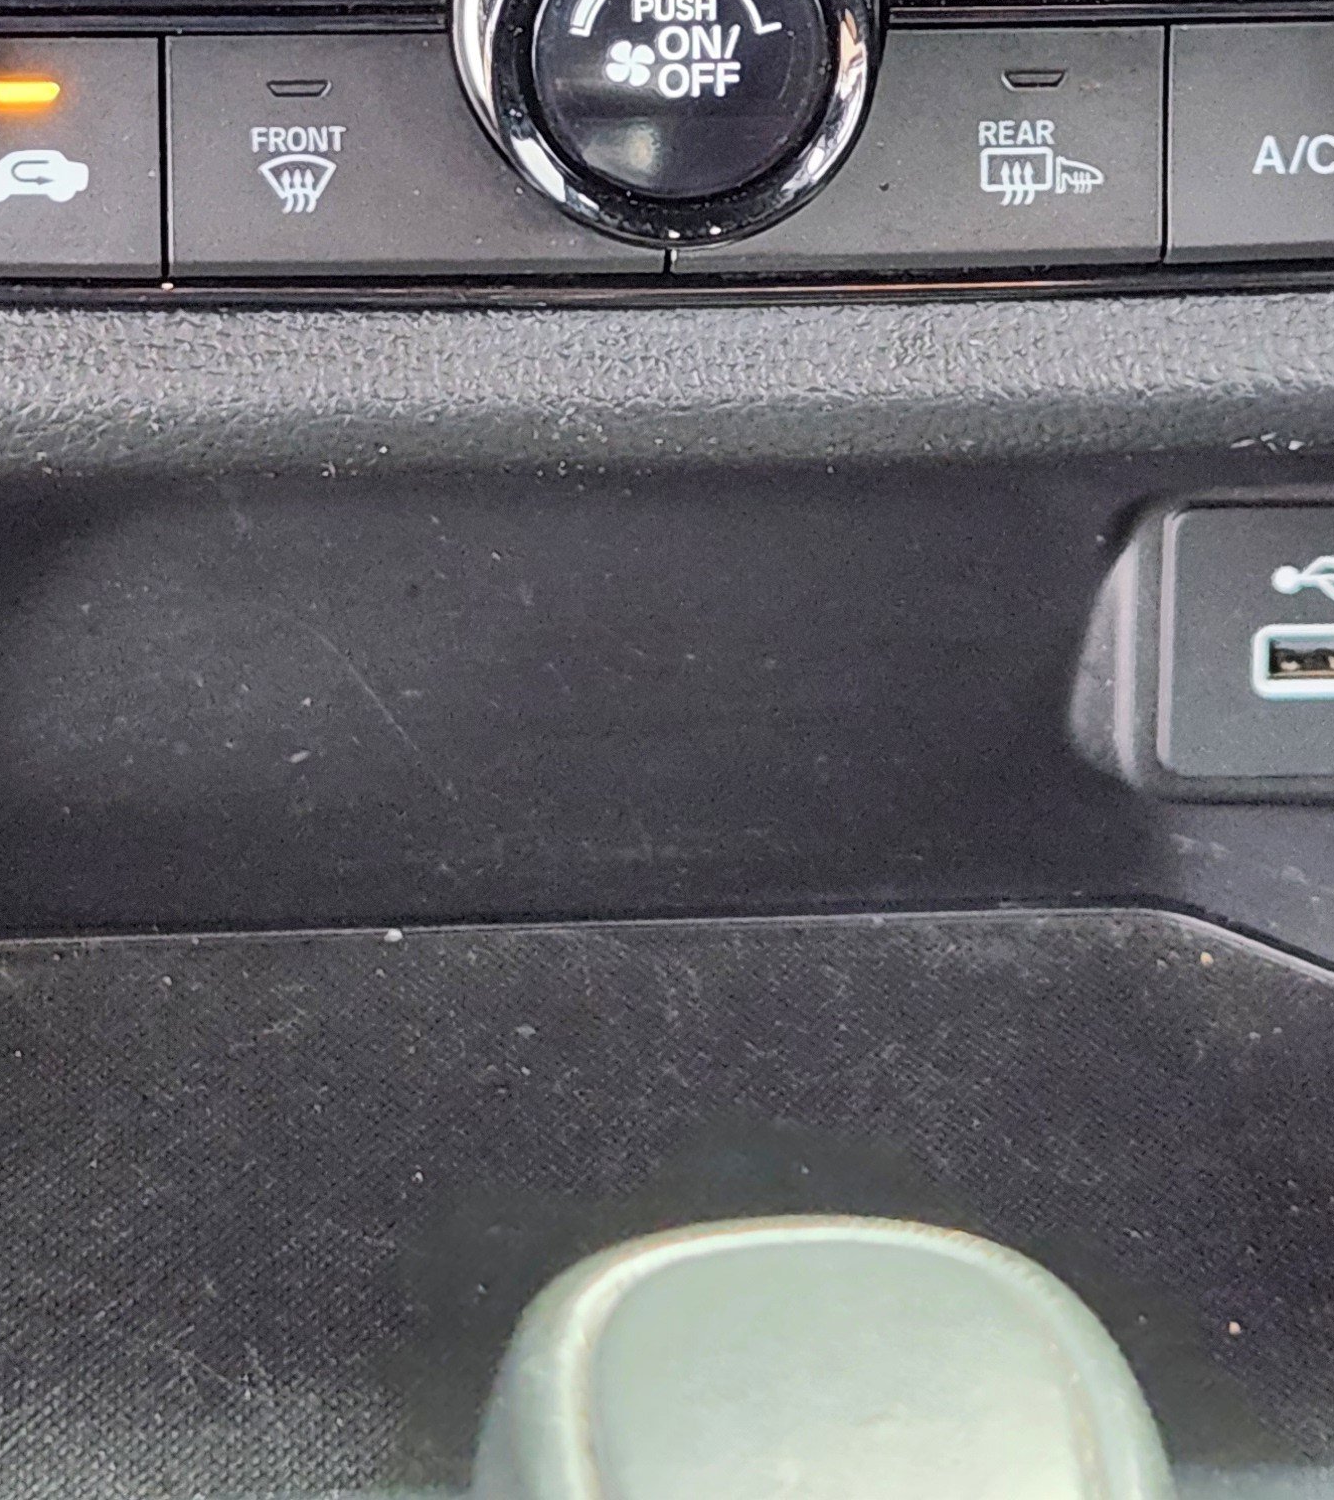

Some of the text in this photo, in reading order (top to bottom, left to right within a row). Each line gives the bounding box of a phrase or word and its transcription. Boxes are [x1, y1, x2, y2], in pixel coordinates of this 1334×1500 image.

[656, 23, 740, 61] ON/
[656, 61, 742, 99] OFF
[249, 125, 347, 153] FRONT
[978, 119, 1056, 147] REAR
